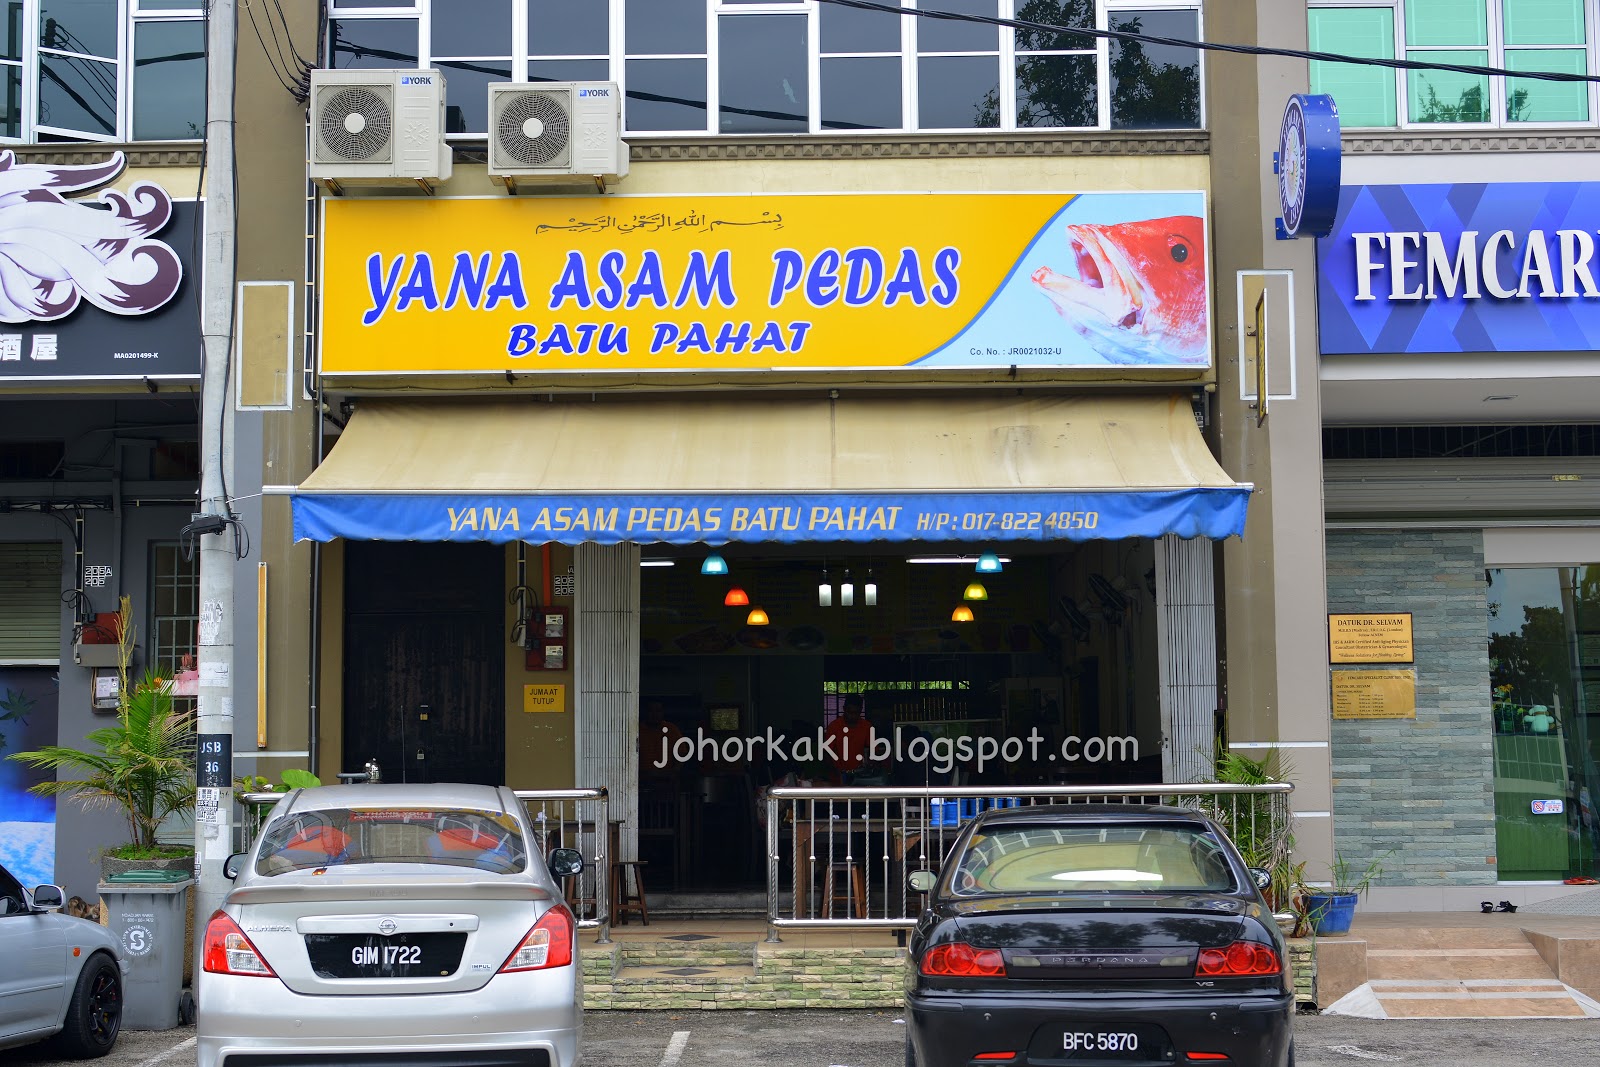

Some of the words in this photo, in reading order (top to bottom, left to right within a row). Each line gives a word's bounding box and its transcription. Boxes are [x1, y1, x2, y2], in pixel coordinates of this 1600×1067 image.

[410, 77, 432, 85] YORK
[586, 89, 610, 97] YORK
[1351, 229, 1600, 301] FEMCAR
[362, 250, 529, 326] YANA
[548, 249, 738, 310] ASAM
[768, 246, 962, 309] PEDAS
[506, 322, 629, 358] BATU
[649, 321, 812, 354] PAHAT
[969, 347, 984, 356] Co.
[986, 347, 1000, 356] No.
[1007, 347, 1063, 356] JR0021032-U
[447, 507, 520, 531] YANA
[531, 507, 619, 531] ASAM
[626, 507, 723, 532] PEDAS
[730, 507, 801, 531] BATU
[808, 506, 903, 531] PAHAT
[85, 566, 113, 576] 205A
[85, 577, 106, 586] 205
[1376, 618, 1403, 626] SELVAM
[533, 697, 555, 705] TUTUP
[201, 741, 222, 754] JSB
[205, 761, 219, 773] 36
[247, 925, 292, 933] ALMERA
[384, 945, 422, 964] 1722
[1052, 956, 1149, 964] PERDANA
[1062, 1032, 1094, 1051] BFC
[1097, 1032, 1138, 1051] 5870
